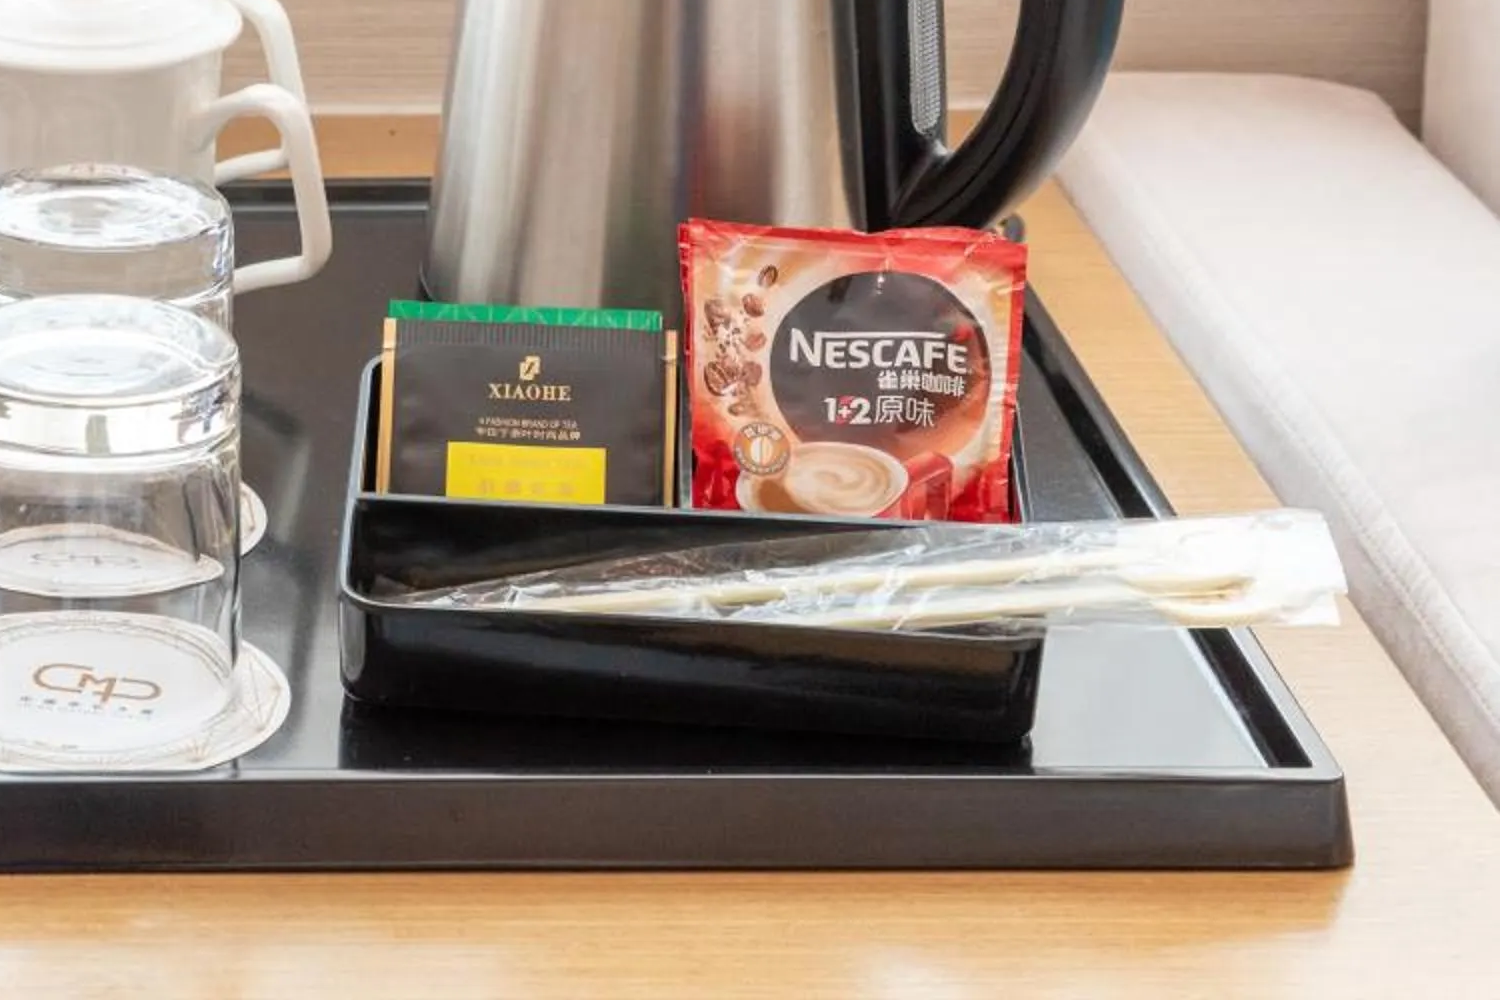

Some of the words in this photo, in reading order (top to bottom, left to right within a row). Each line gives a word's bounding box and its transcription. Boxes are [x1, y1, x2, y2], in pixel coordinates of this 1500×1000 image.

[488, 383, 572, 402] XIAOHE
[877, 369, 966, 397] 雀巢咖啡
